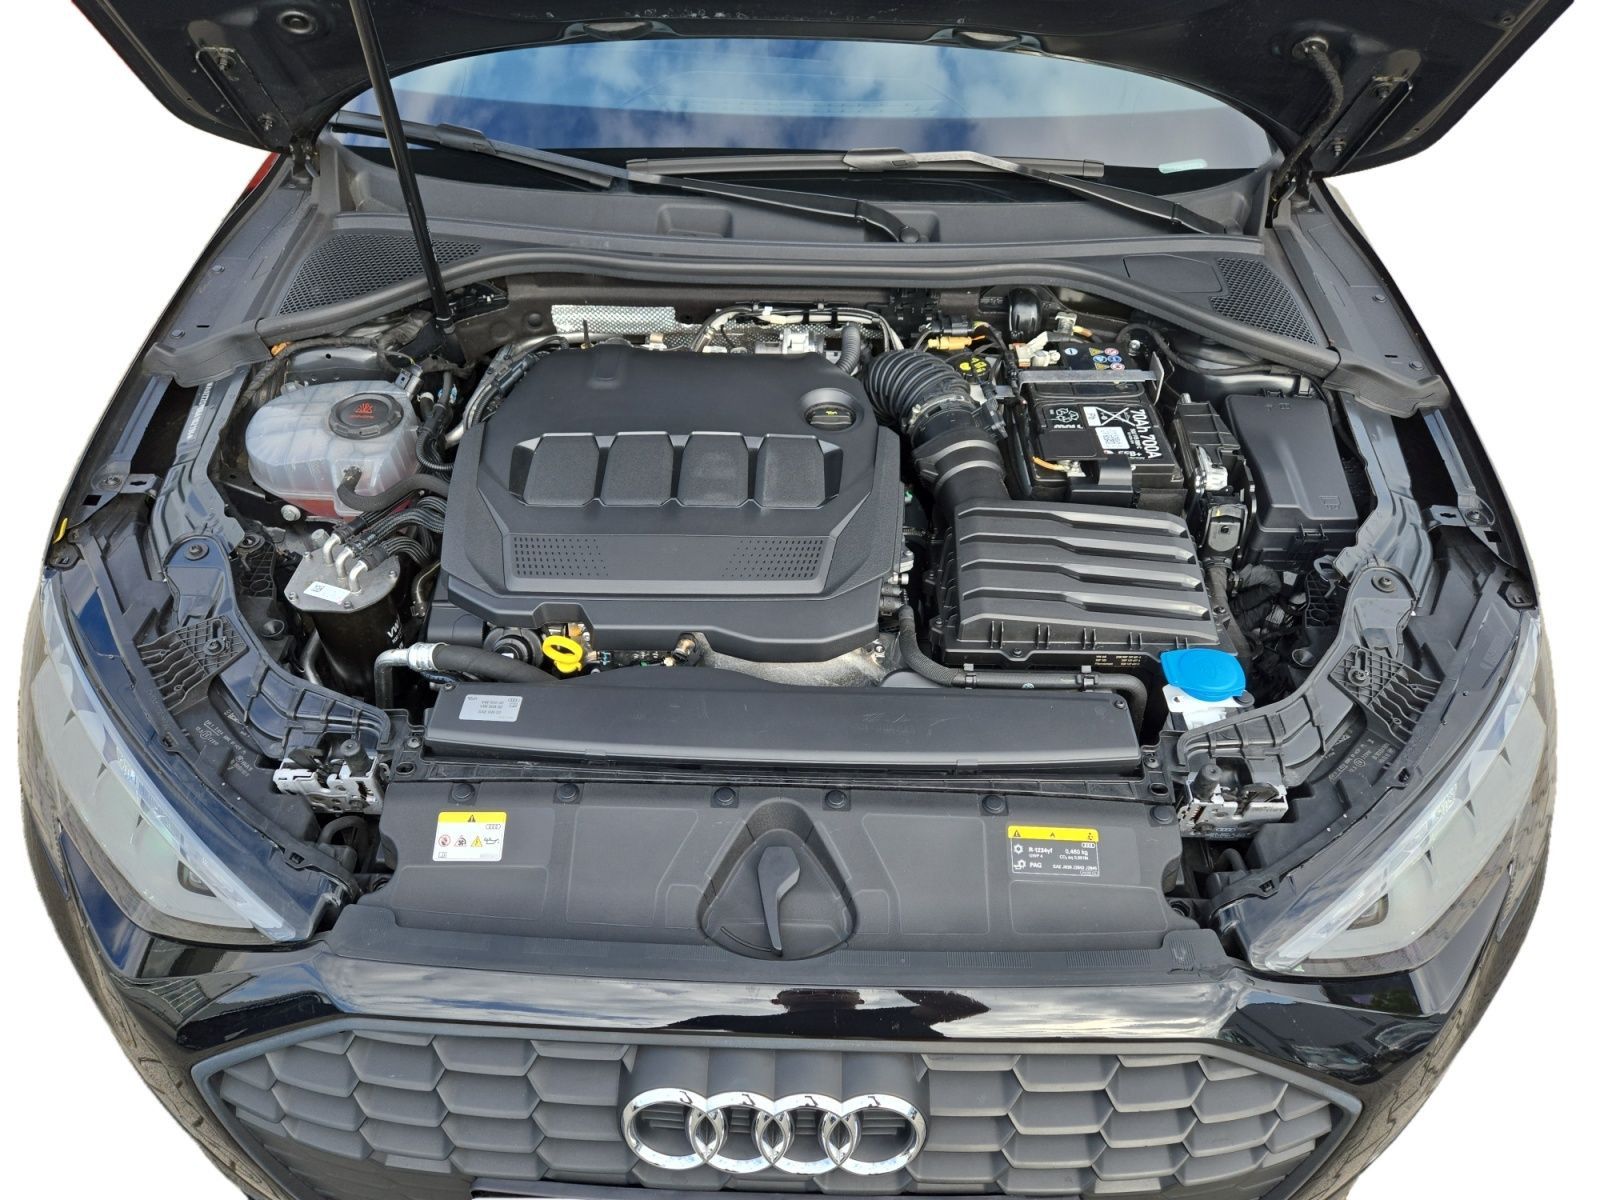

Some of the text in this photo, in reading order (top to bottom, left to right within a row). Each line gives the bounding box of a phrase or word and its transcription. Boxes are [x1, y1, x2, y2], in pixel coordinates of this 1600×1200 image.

[1130, 409, 1151, 433] 70Ah
[1140, 434, 1162, 459] 700A
[1028, 847, 1053, 855] R-1234yf
